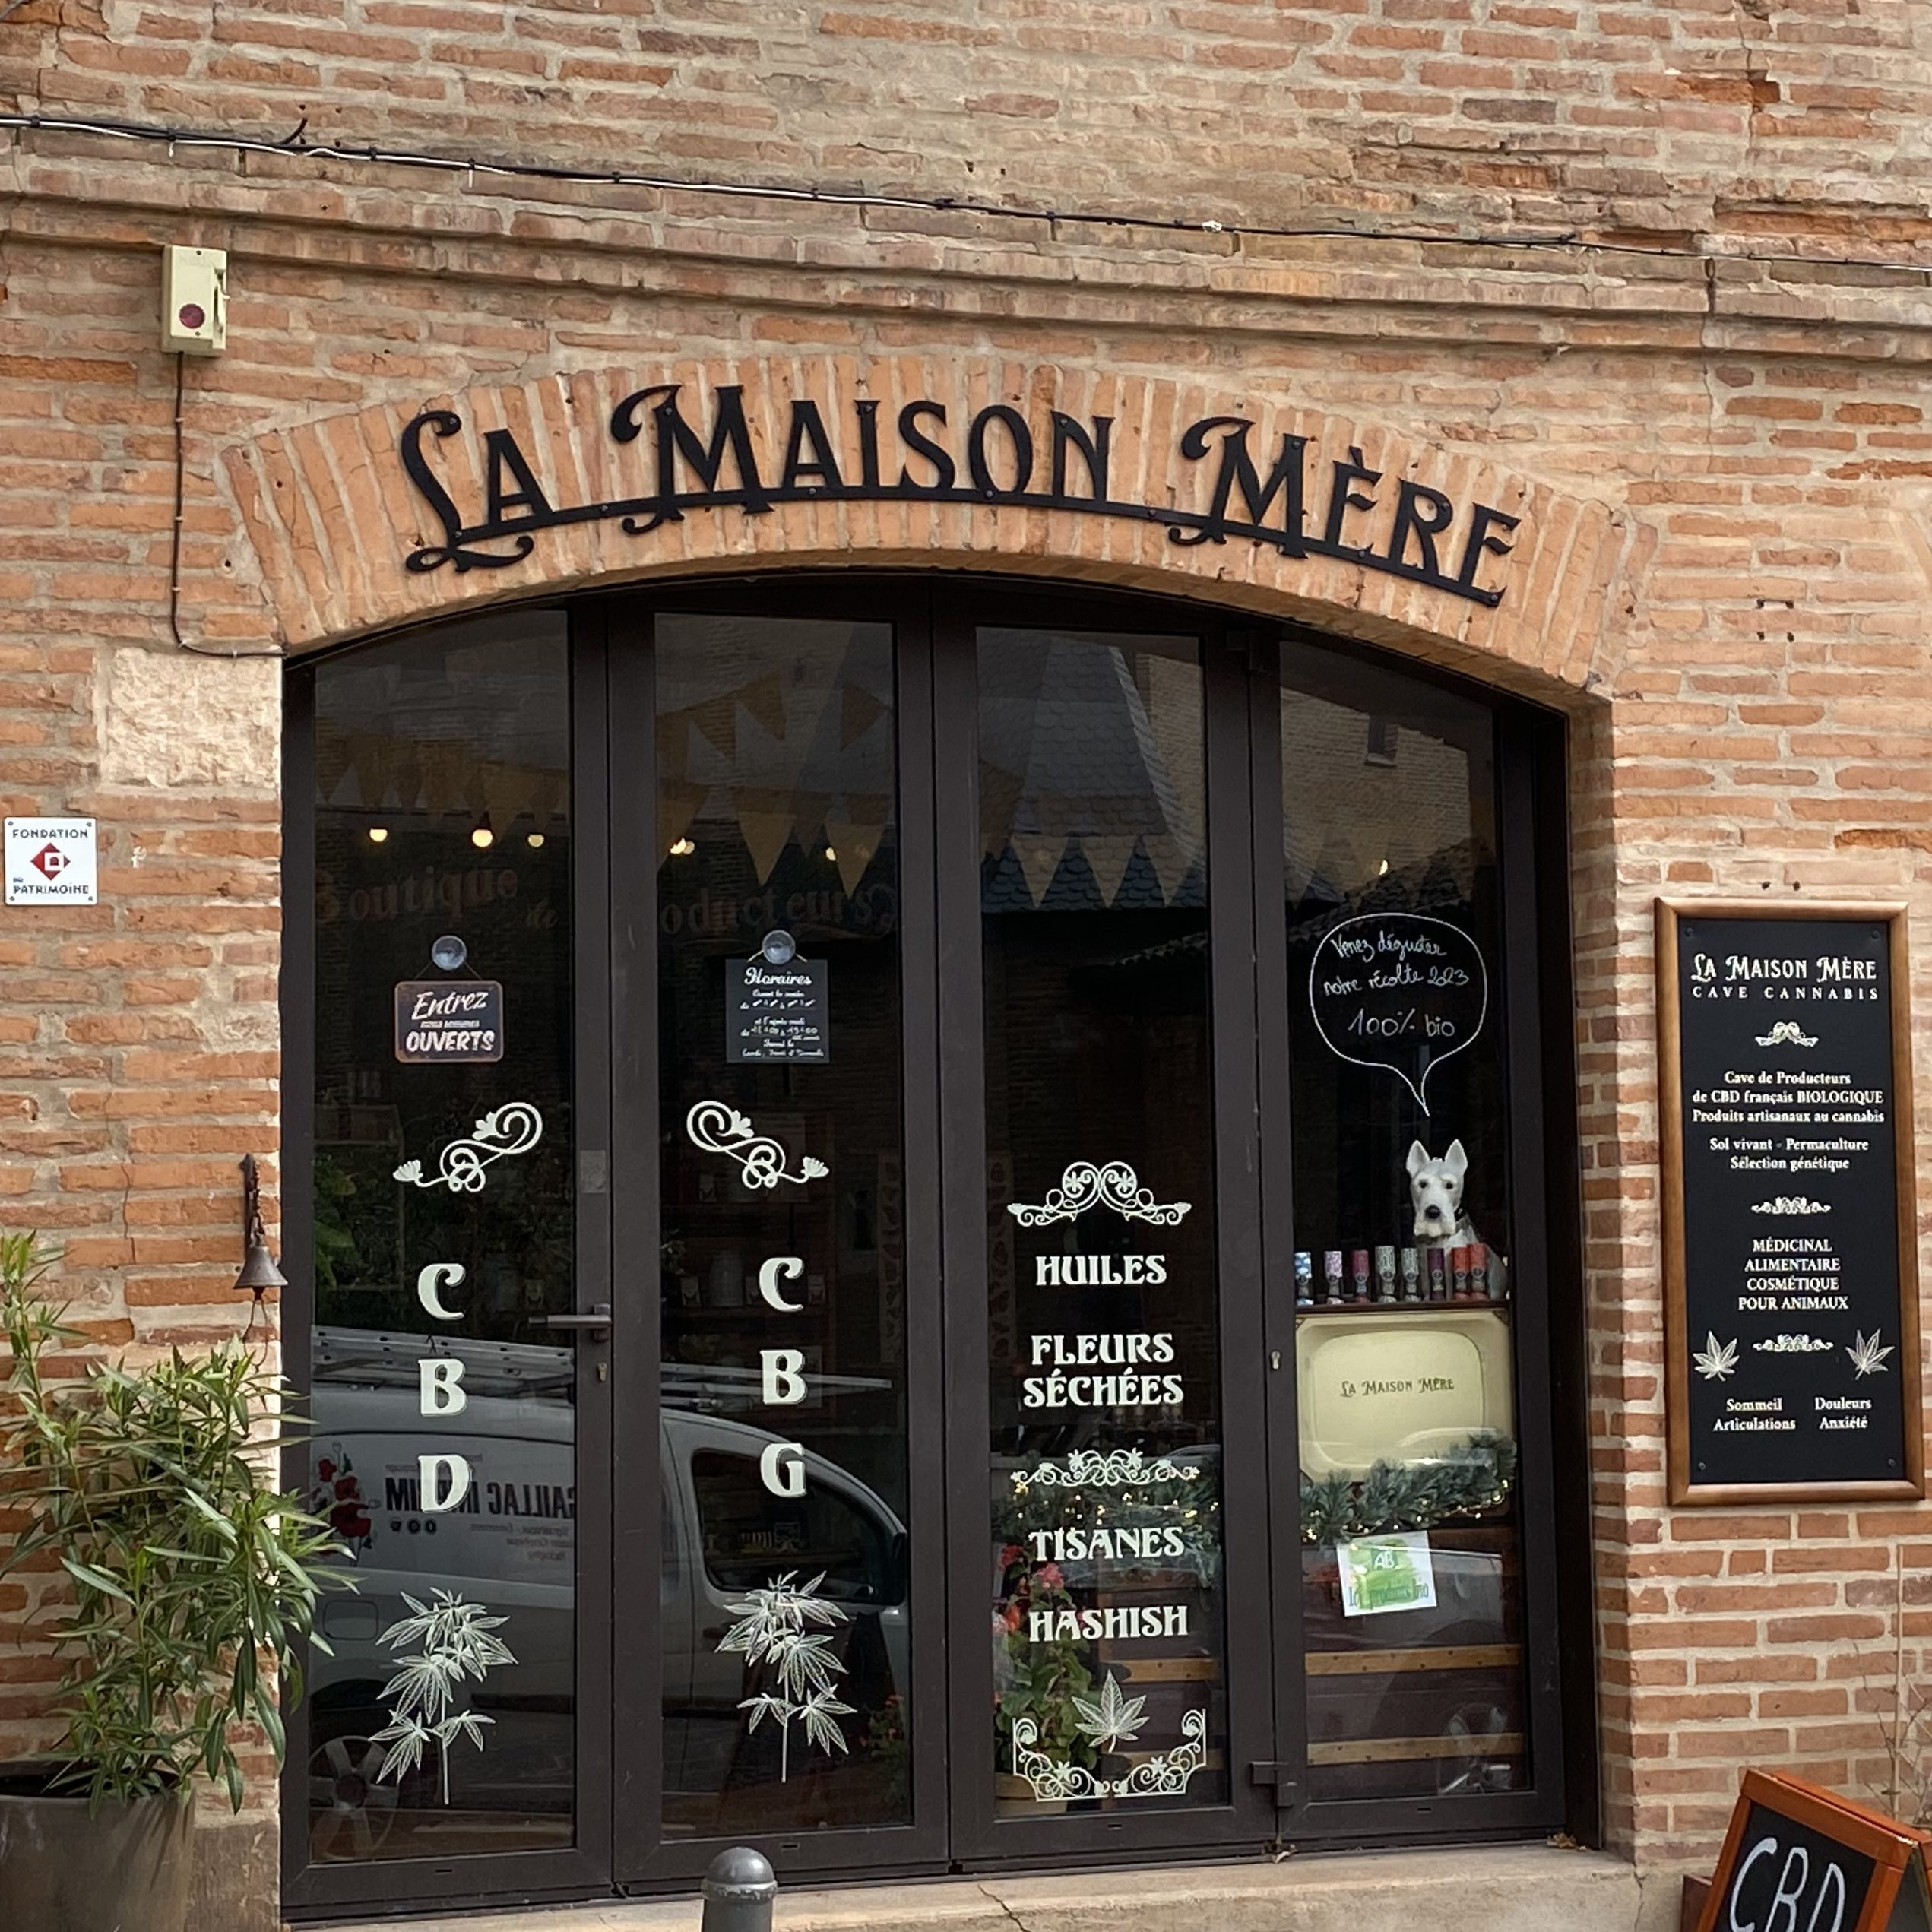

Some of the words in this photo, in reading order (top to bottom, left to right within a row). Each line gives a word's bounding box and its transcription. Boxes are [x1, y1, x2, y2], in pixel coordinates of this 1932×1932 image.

[401, 410, 555, 573] LA
[610, 385, 1115, 534] MAISON
[1168, 415, 1520, 608] MÈRE
[12, 829, 88, 838] FONDATION
[13, 885, 89, 894] PATRIMOINE
[1329, 932, 1376, 964] Venez
[744, 967, 812, 985] Horaires
[1367, 962, 1424, 989] récolte
[1426, 965, 1470, 987] 2023
[1691, 954, 1716, 982] LA
[1725, 956, 1807, 981] MAISON
[1816, 956, 1876, 983] MÈRE
[1693, 987, 1747, 998] CAVE
[1764, 987, 1877, 999] CANNABIS
[411, 991, 489, 1020] Entrez
[1347, 1007, 1417, 1037] 100%
[1424, 1012, 1456, 1037] bio
[407, 1031, 494, 1052] OUVERTS
[1725, 1071, 1754, 1083] Cave
[1758, 1071, 1772, 1084] de
[1777, 1071, 1851, 1084] Producteurs
[1693, 1090, 1707, 1103] de
[1711, 1090, 1740, 1103] CBD
[1744, 1090, 1794, 1104] français
[1797, 1090, 1883, 1105] BIOLOGIQUE
[1693, 1109, 1744, 1122] Produits
[1747, 1109, 1810, 1122] artisanaux
[1814, 1113, 1829, 1122] au
[1832, 1110, 1884, 1122] cannabis
[1710, 1138, 1729, 1150] Sol
[1733, 1138, 1772, 1150] vivant
[1786, 1138, 1868, 1150] Permaculture
[1731, 1155, 1787, 1169] Sélection
[1790, 1156, 1849, 1172] génétique
[1753, 1237, 1832, 1252] MÉDICINAL
[1036, 1255, 1167, 1285] HUILES
[1745, 1258, 1840, 1272] ALIMENTAIRE
[1747, 1275, 1839, 1292] COSMÉTIQUE
[1739, 1297, 1778, 1310] POUR
[1782, 1297, 1848, 1309] ANIMAUX
[1031, 1333, 1173, 1365] FLEURS
[759, 1256, 808, 1497] CBG
[1024, 1367, 1183, 1407] SÉCHÉES
[417, 1262, 473, 1513] CBD
[1340, 1381, 1357, 1398] LA
[1361, 1380, 1413, 1395] MAISON
[1418, 1377, 1455, 1393] MÈRE
[1727, 1398, 1782, 1411] Sommeil
[1815, 1397, 1871, 1410] Douleurs
[1713, 1417, 1795, 1431] Articulations
[1820, 1416, 1867, 1429] Anxiété
[1028, 1526, 1185, 1563] TISANES
[1028, 1605, 1189, 1642] HASHISH
[1730, 1837, 1845, 1932] CBD
